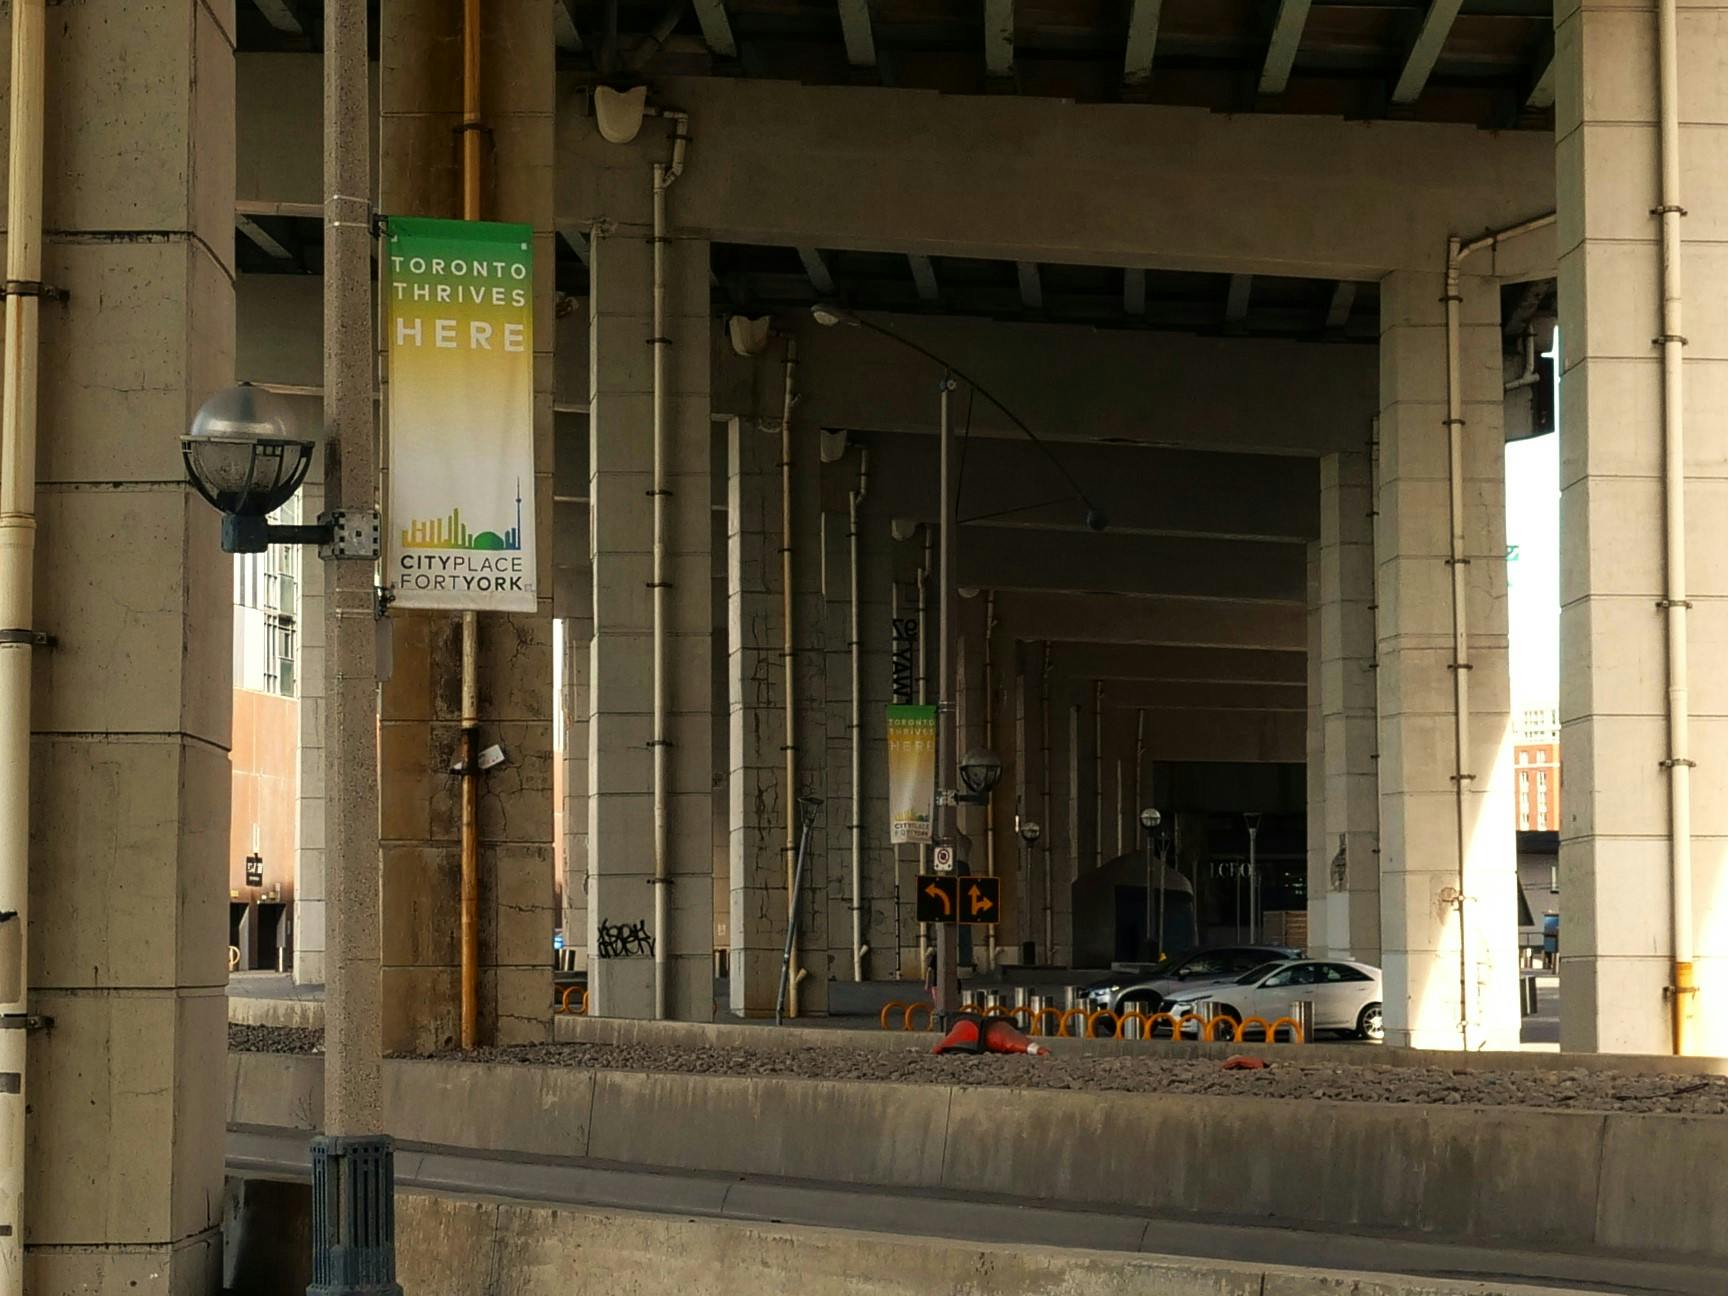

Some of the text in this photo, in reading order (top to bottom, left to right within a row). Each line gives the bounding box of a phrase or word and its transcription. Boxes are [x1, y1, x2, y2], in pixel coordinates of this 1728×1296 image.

[390, 255, 527, 280] TORONTO
[392, 281, 526, 307] THRIVES
[396, 317, 525, 353] HERE
[399, 553, 523, 573] CITYPLACE
[399, 573, 523, 592] FORTYORK
[888, 718, 935, 727] TORONTO
[890, 740, 934, 752] HERE
